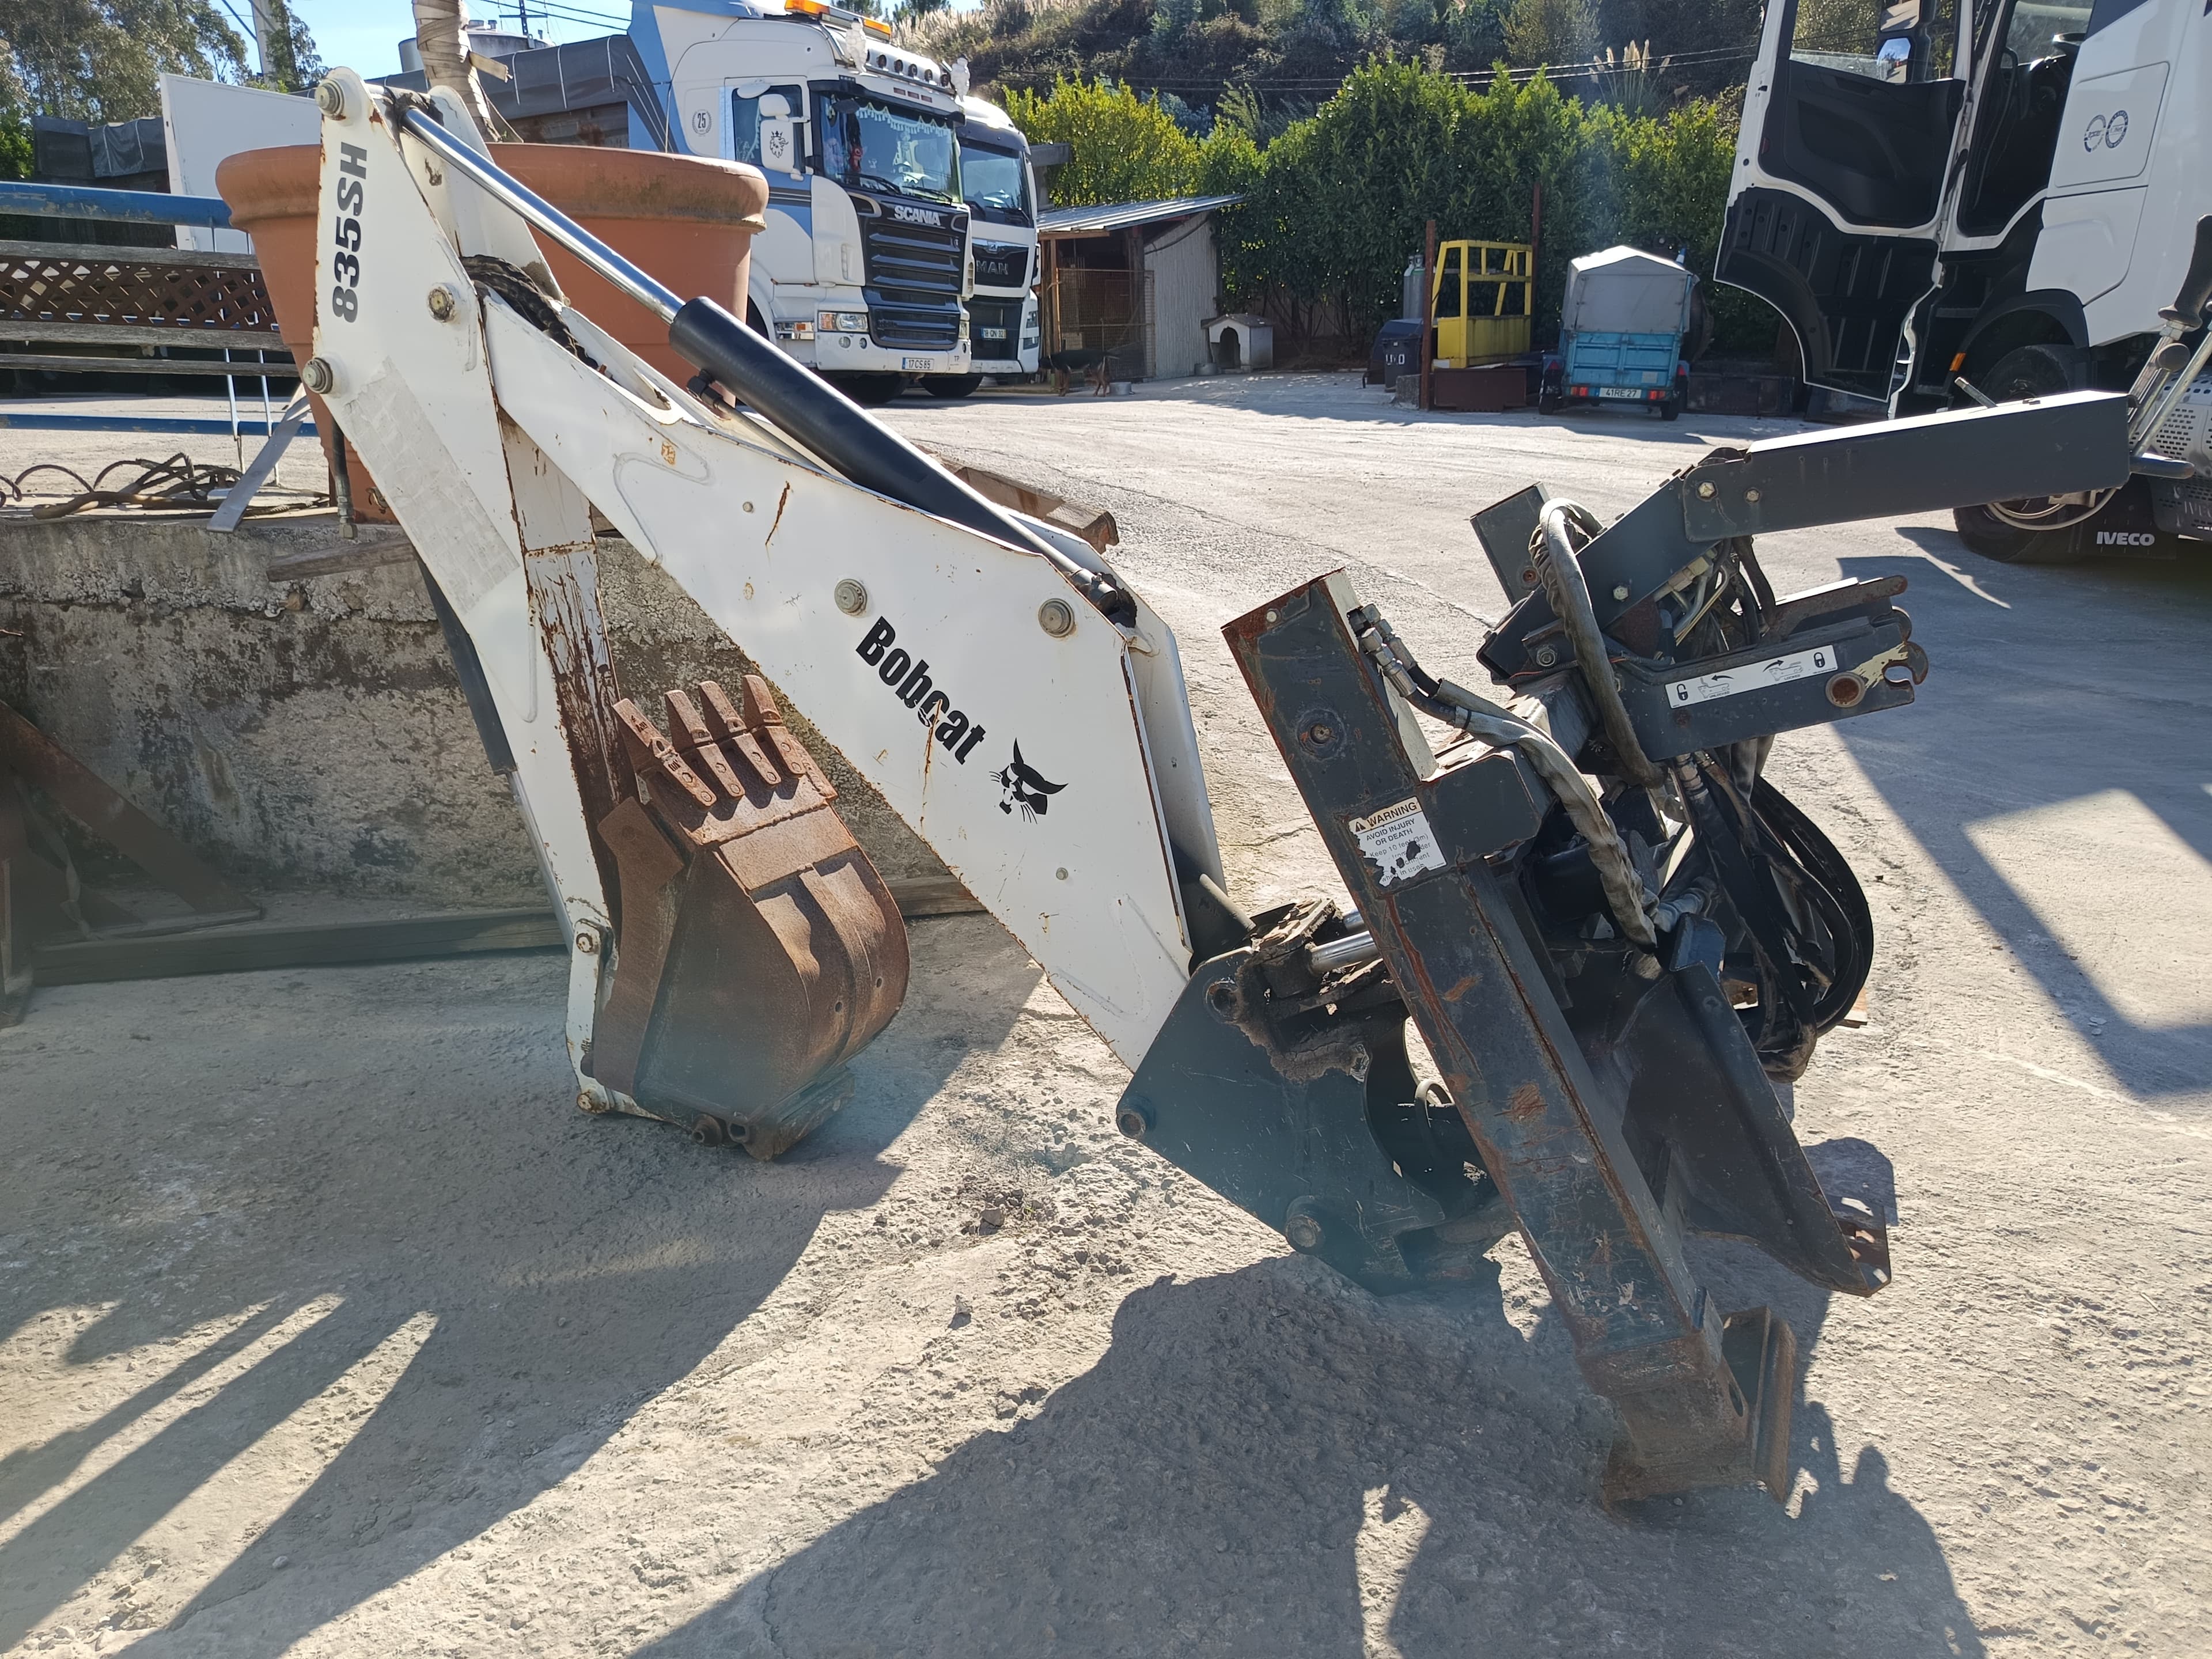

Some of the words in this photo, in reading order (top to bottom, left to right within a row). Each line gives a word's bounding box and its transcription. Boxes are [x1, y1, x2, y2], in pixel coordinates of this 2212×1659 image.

[698, 113, 706, 128] 25
[894, 205, 941, 226] SCANIA
[332, 141, 368, 324] 835SH
[976, 260, 1009, 275] MAN
[2097, 531, 2155, 546] IVECO
[855, 616, 986, 765] Bobcat
[1366, 802, 1417, 827] WARNING
[1366, 828, 1388, 841] AVOID
[1388, 818, 1415, 833] INJURY
[1375, 838, 1387, 846] OR
[1388, 828, 1413, 842] DEATH
[1369, 849, 1387, 858] Keep
